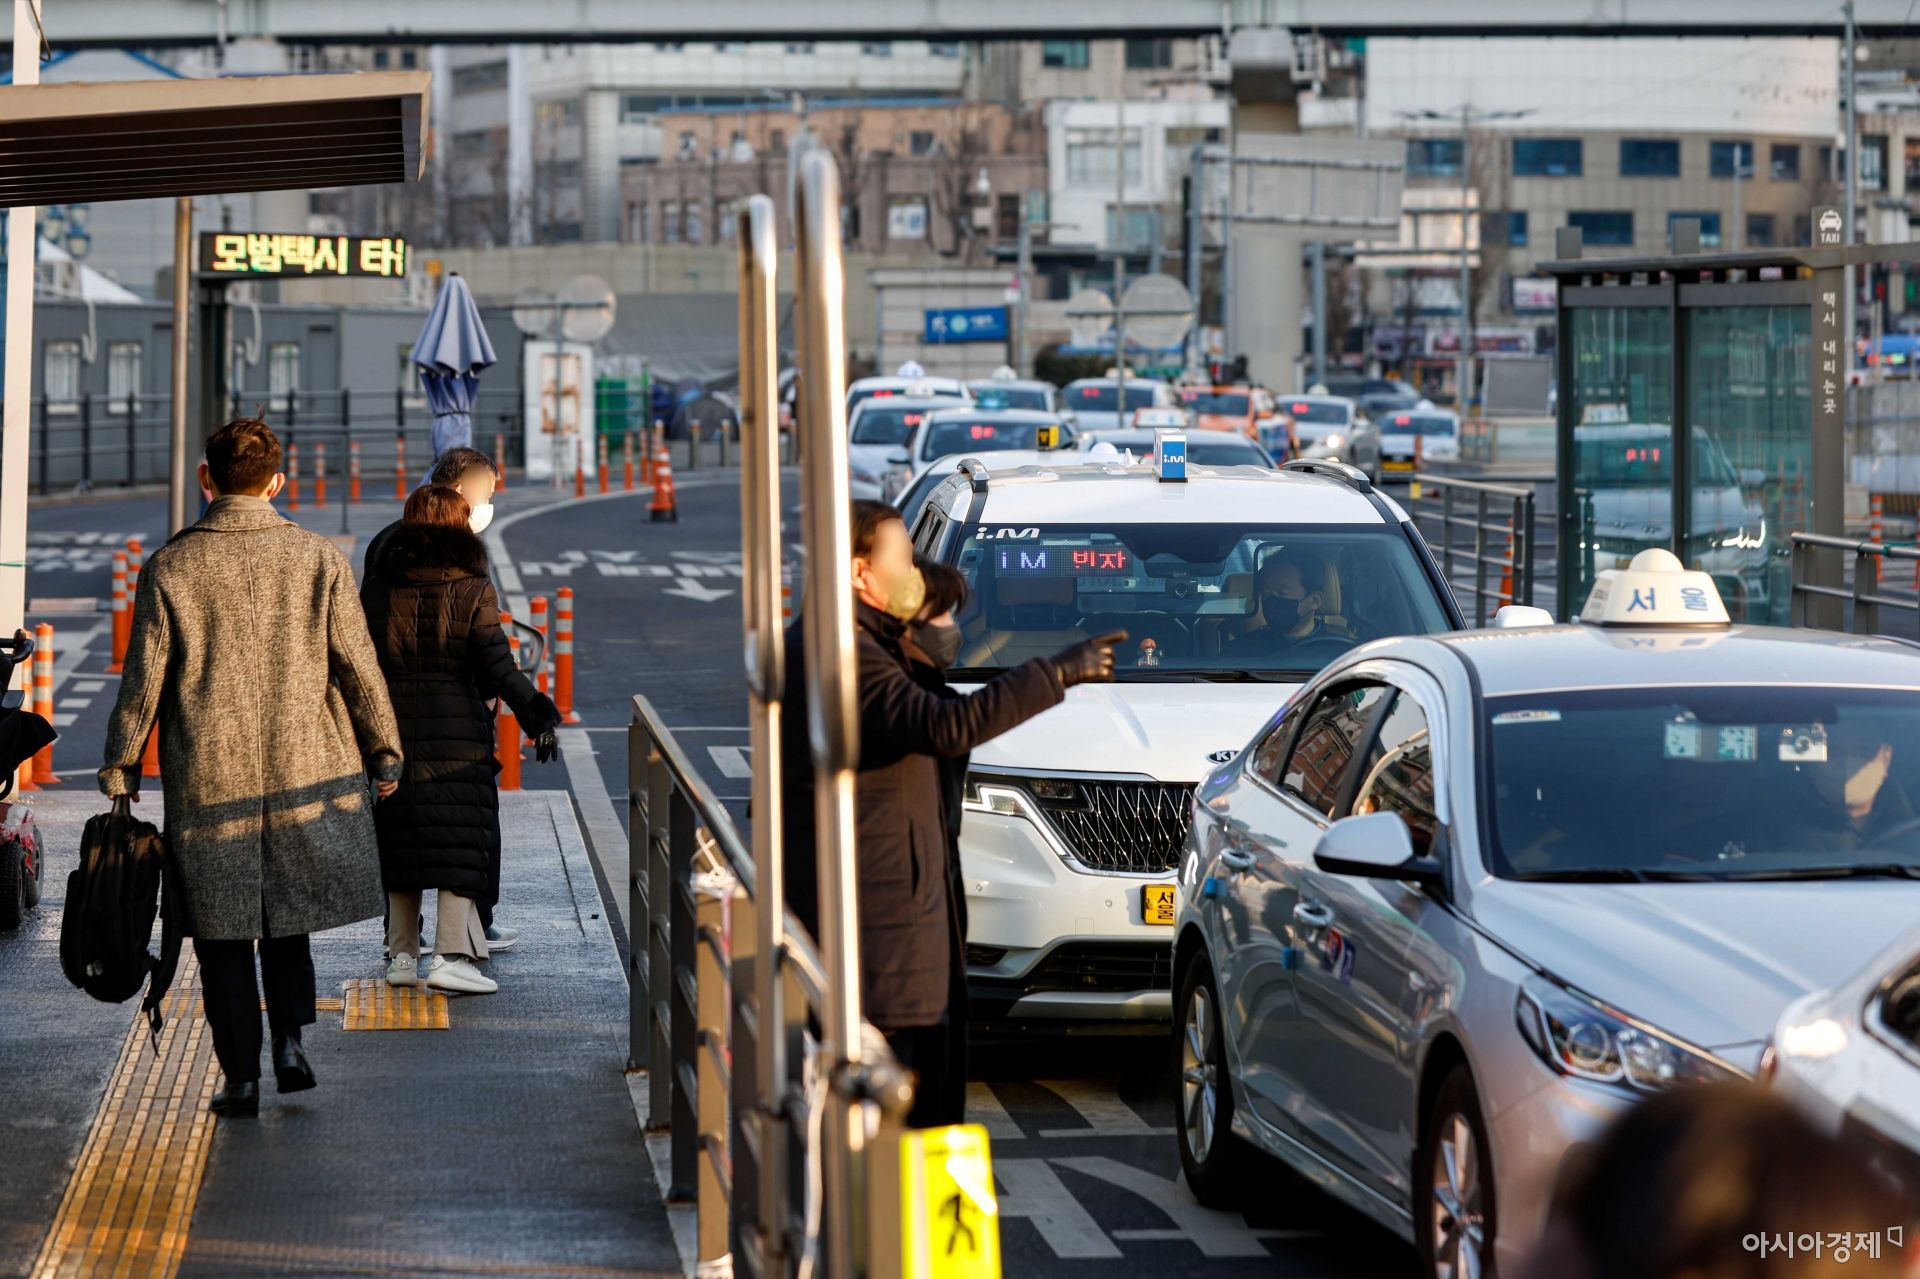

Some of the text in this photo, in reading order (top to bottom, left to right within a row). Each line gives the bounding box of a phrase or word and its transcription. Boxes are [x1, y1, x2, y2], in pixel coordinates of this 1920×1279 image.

[213, 234, 348, 275] 모범택시
[1820, 233, 1840, 243] TAXI
[1822, 292, 1837, 327] 택시
